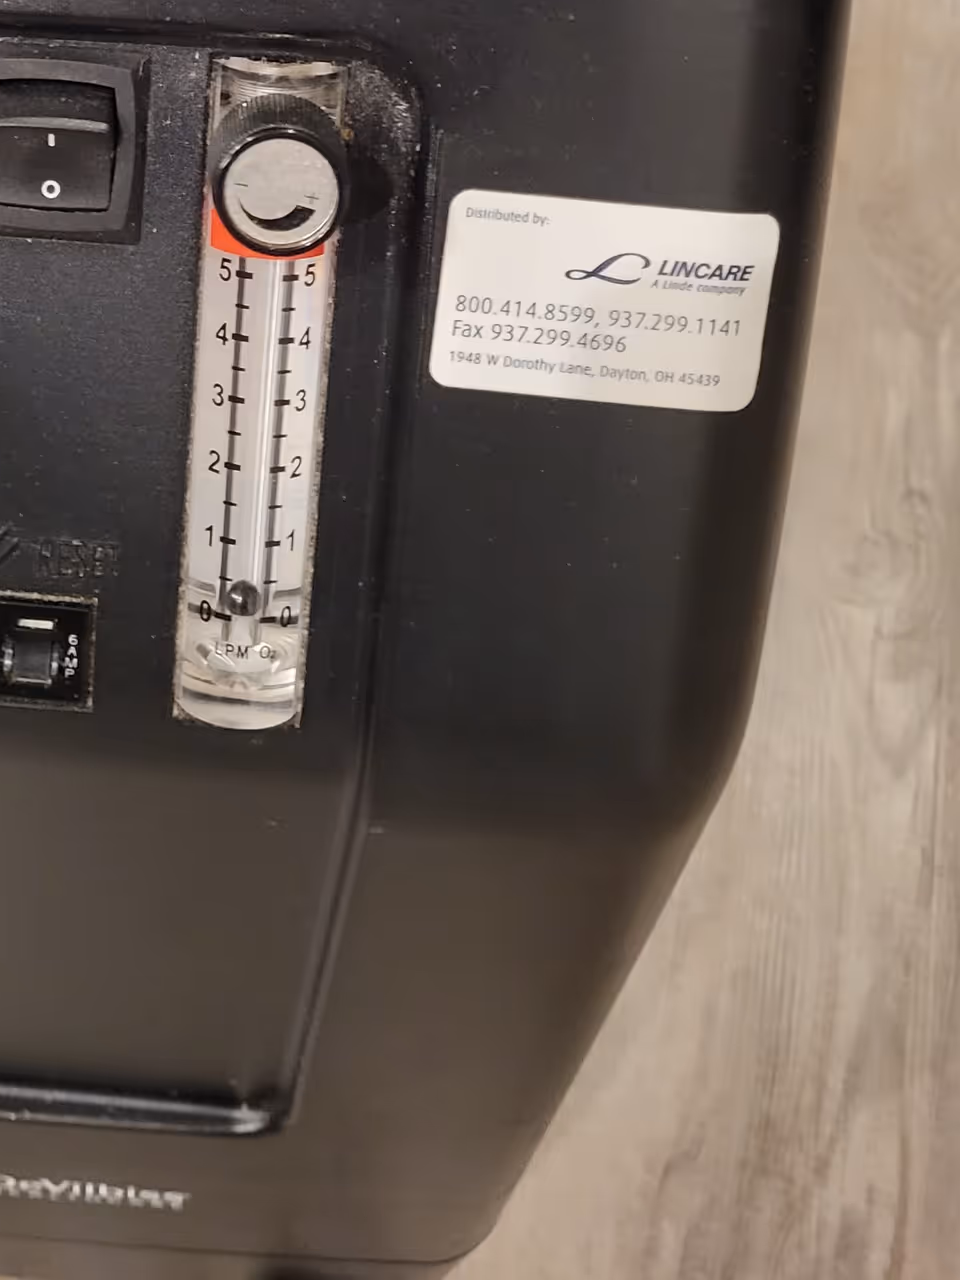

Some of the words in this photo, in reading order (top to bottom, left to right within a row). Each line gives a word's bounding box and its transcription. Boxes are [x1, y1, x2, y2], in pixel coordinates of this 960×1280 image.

[465, 207, 530, 224] Distributed
[532, 213, 551, 227] by:
[219, 257, 233, 282] 5
[304, 263, 317, 287] 5
[657, 259, 756, 283] LINCARE
[650, 280, 660, 290] A
[661, 280, 694, 293] Linde
[696, 283, 747, 297] company
[455, 294, 601, 328] 800.414.8599,
[608, 309, 742, 338] 937.299.1141
[215, 322, 229, 346] 4
[298, 326, 312, 350] 4
[451, 319, 484, 341] Fax
[491, 323, 628, 354] 937.299.4696
[449, 350, 482, 366] 1948
[486, 354, 499, 367] W
[502, 355, 557, 376] Dorothy
[559, 361, 596, 378] Lane,
[599, 365, 651, 384] Dayton,
[654, 370, 675, 384] OH
[677, 372, 721, 388] 45439
[211, 383, 225, 407] 3
[293, 389, 307, 412] 3
[207, 450, 221, 474] 2
[289, 455, 303, 479] 2
[204, 524, 214, 548] 1
[286, 528, 296, 551] 1
[199, 599, 212, 623] 0
[279, 605, 292, 628] 0
[67, 634, 79, 646] 6
[215, 641, 250, 659] LPM
